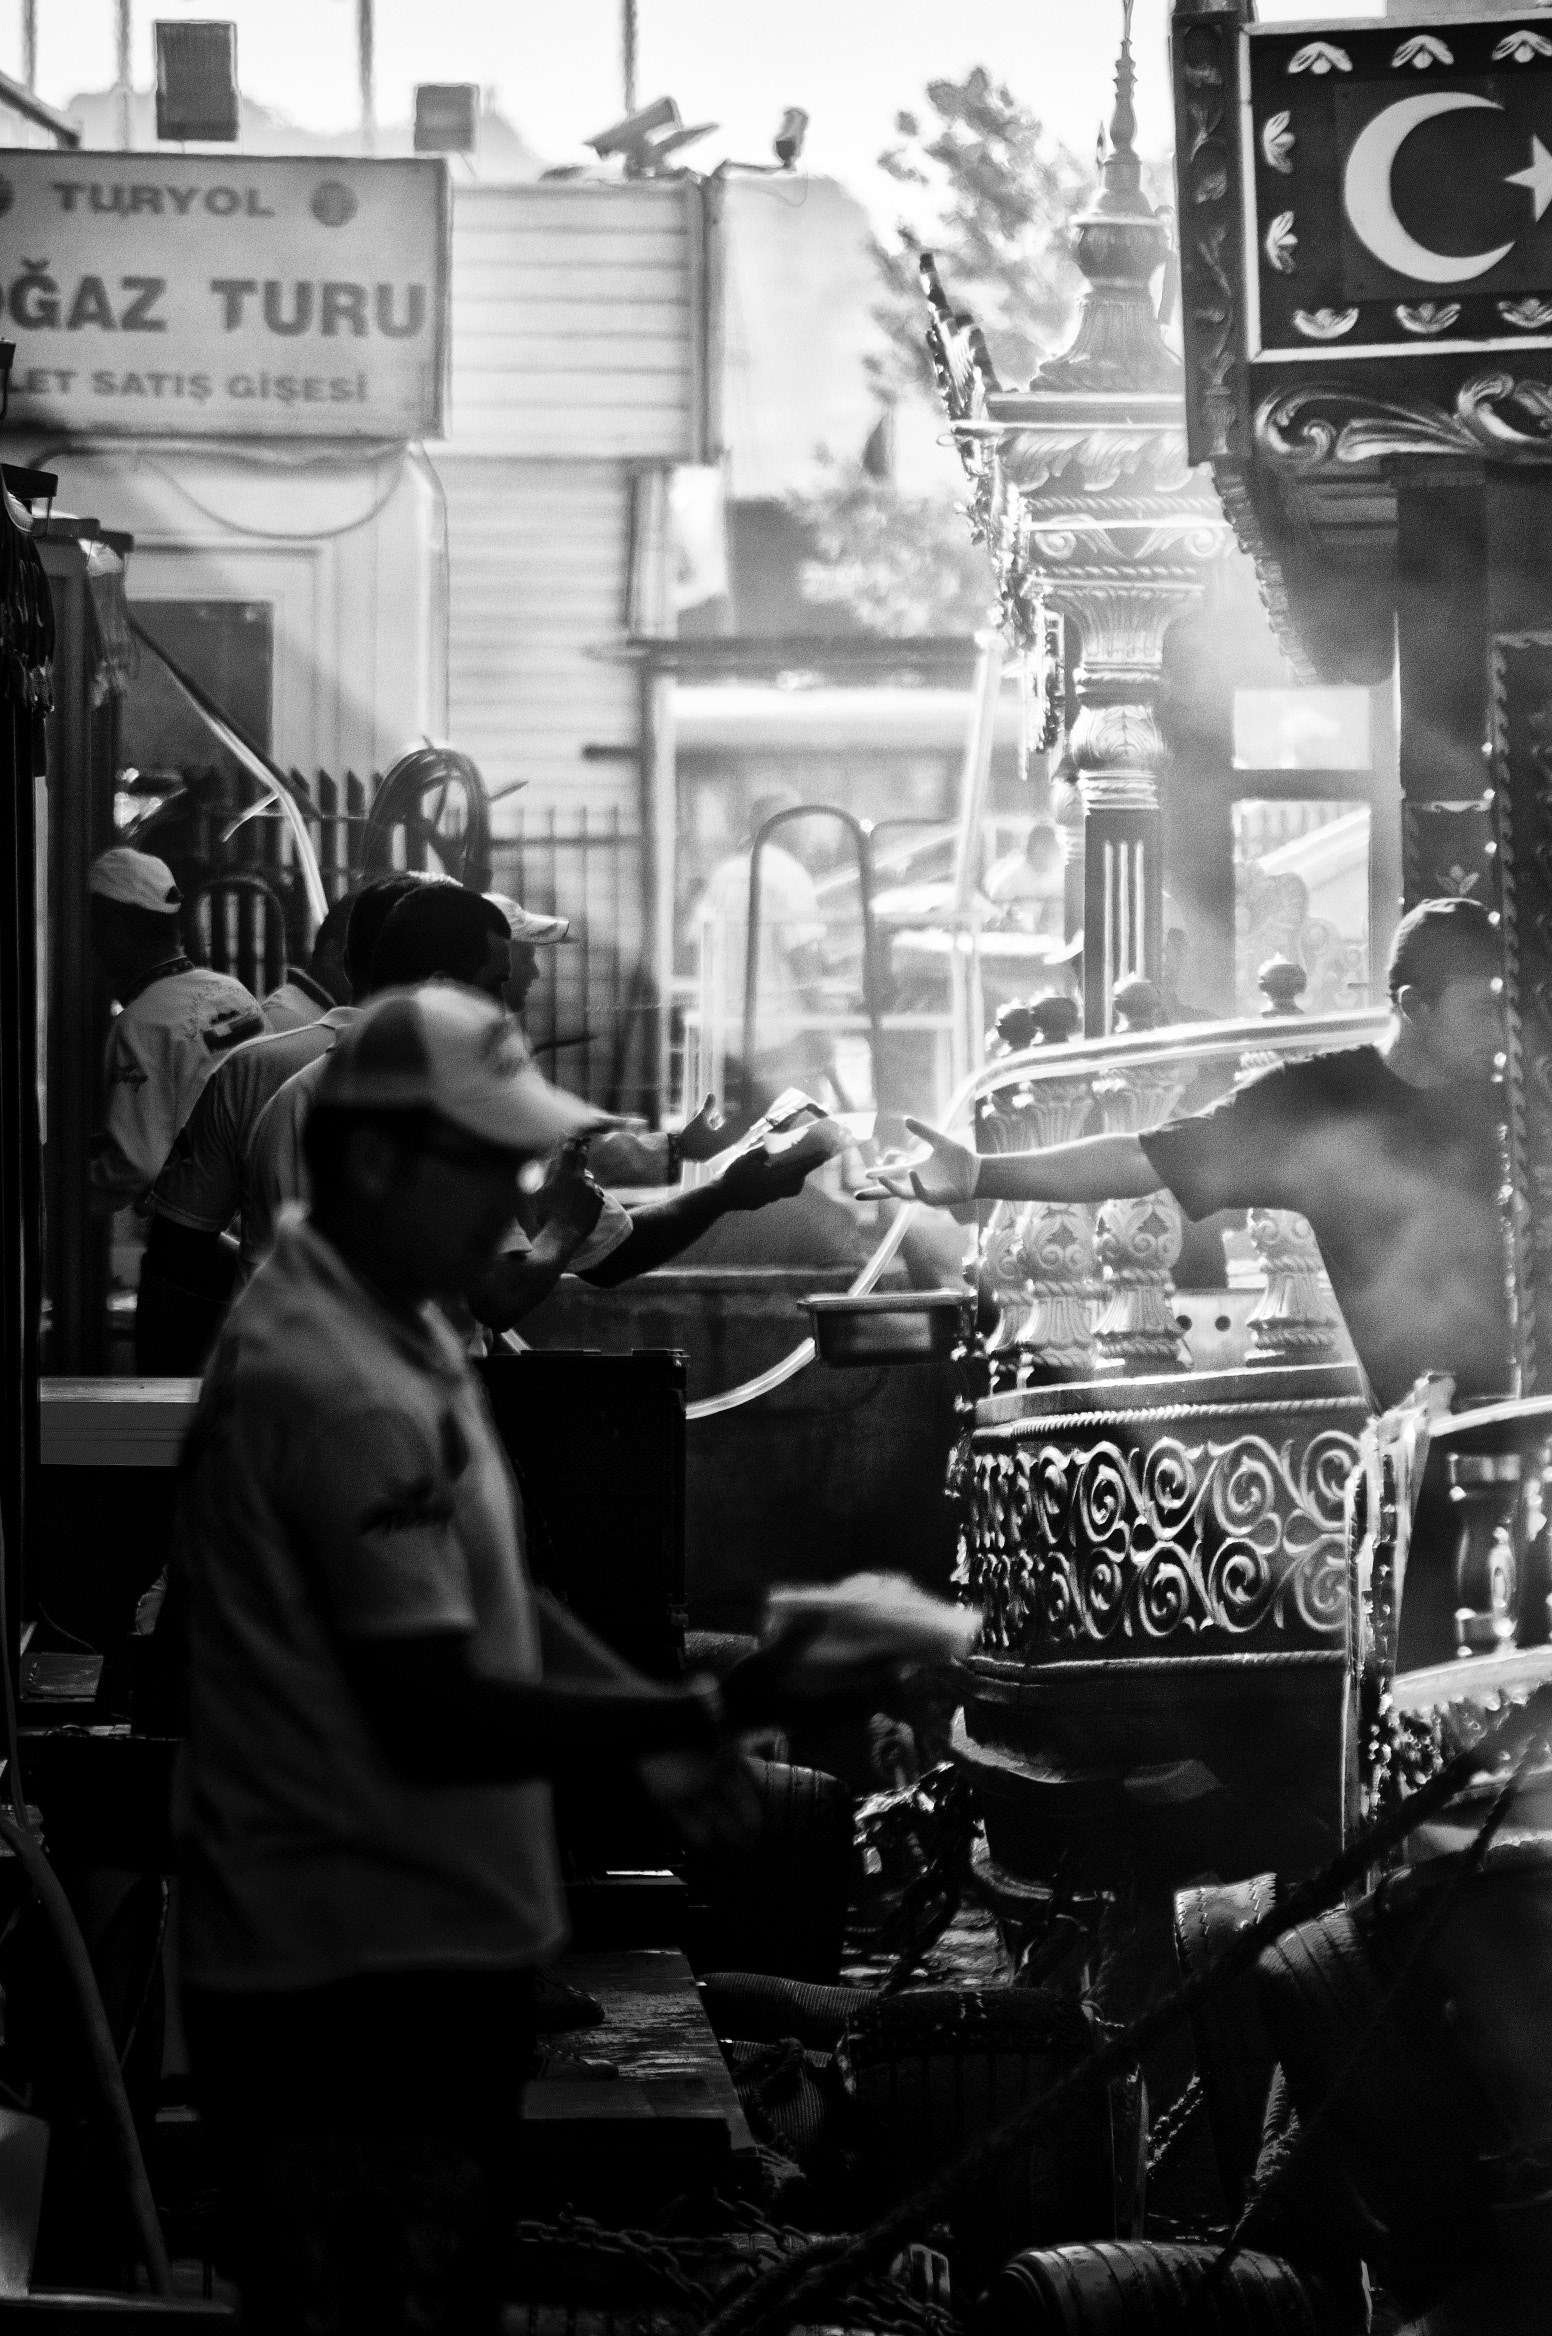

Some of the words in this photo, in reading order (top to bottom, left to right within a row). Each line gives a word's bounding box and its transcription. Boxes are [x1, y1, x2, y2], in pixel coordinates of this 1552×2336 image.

[53, 182, 276, 218] TURYOL
[0, 258, 168, 332] ĞAZ
[209, 277, 427, 338] TURU
[91, 371, 213, 406] SATIŞ
